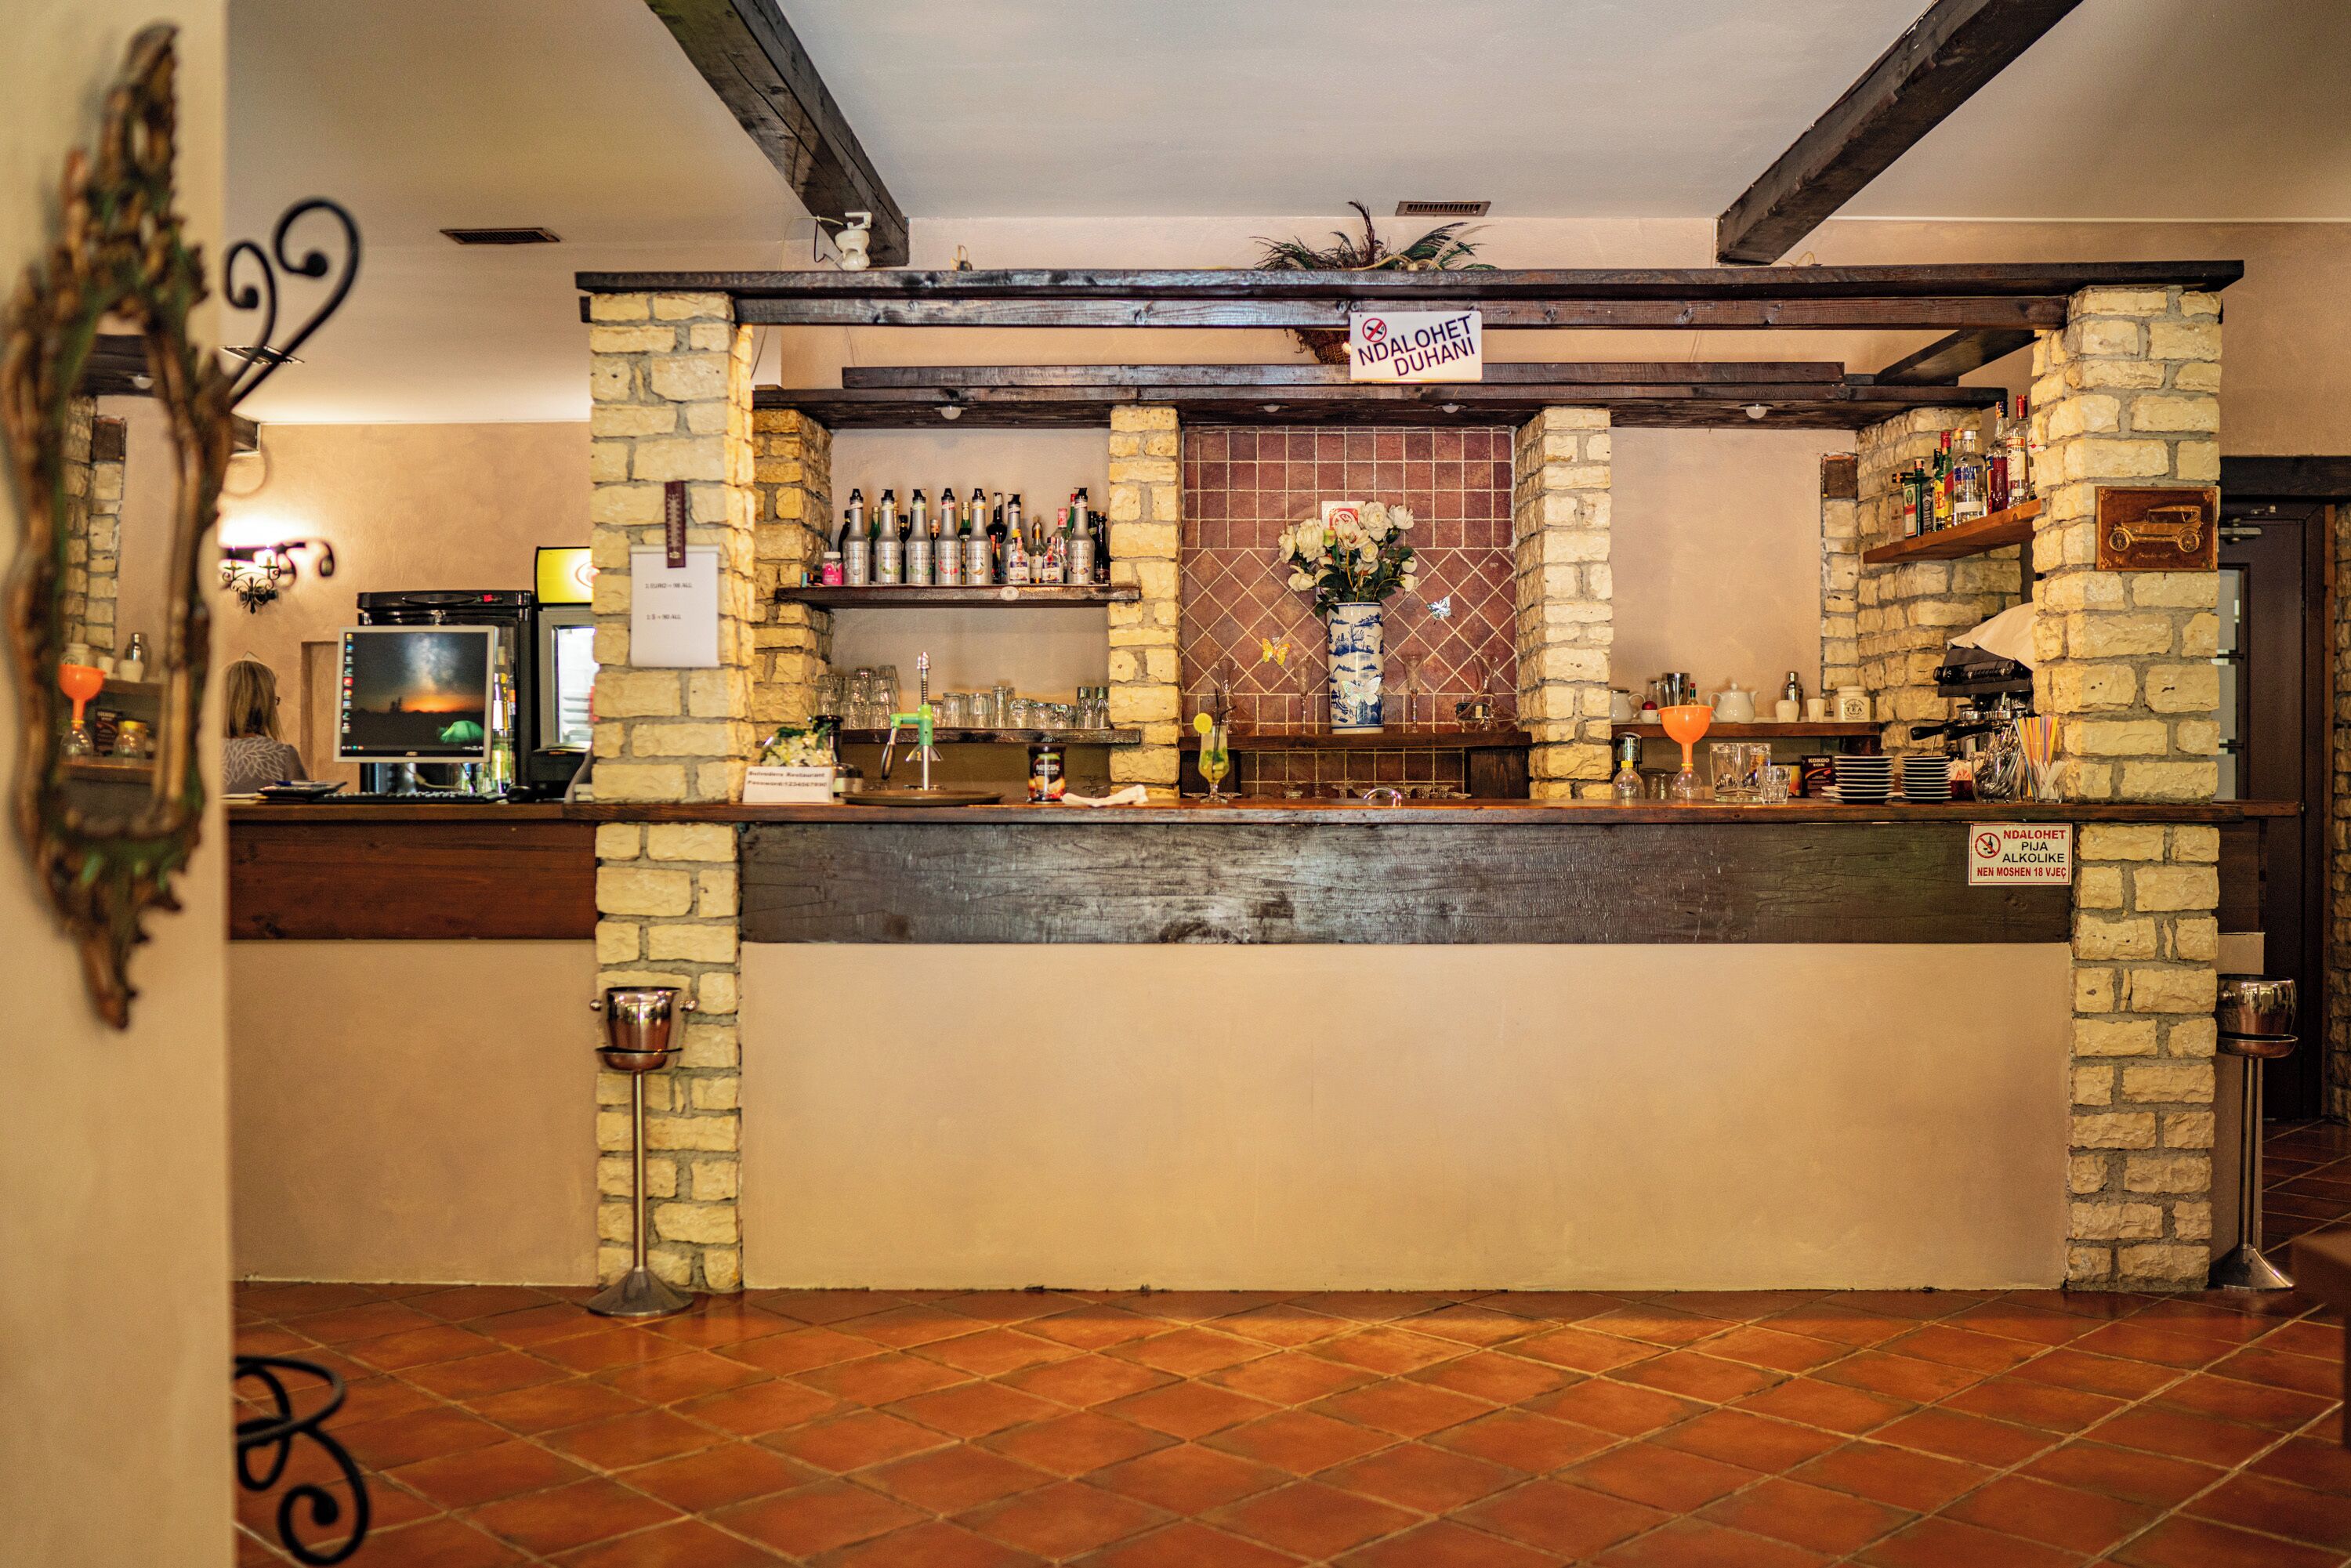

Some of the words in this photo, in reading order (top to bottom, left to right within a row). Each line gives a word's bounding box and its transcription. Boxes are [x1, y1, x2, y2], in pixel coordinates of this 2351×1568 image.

[1358, 315, 1472, 366] NDALOHET
[1394, 337, 1475, 376] DUHANI
[2003, 830, 2066, 839] NDALOHET
[2021, 842, 2048, 851] PIJA
[2002, 853, 2064, 863] ALKOLIKE
[1977, 867, 1994, 876] NEN
[1996, 867, 2031, 876] MOSHEN
[2034, 867, 2043, 876] 18
[2045, 867, 2067, 879] VJEÇ
